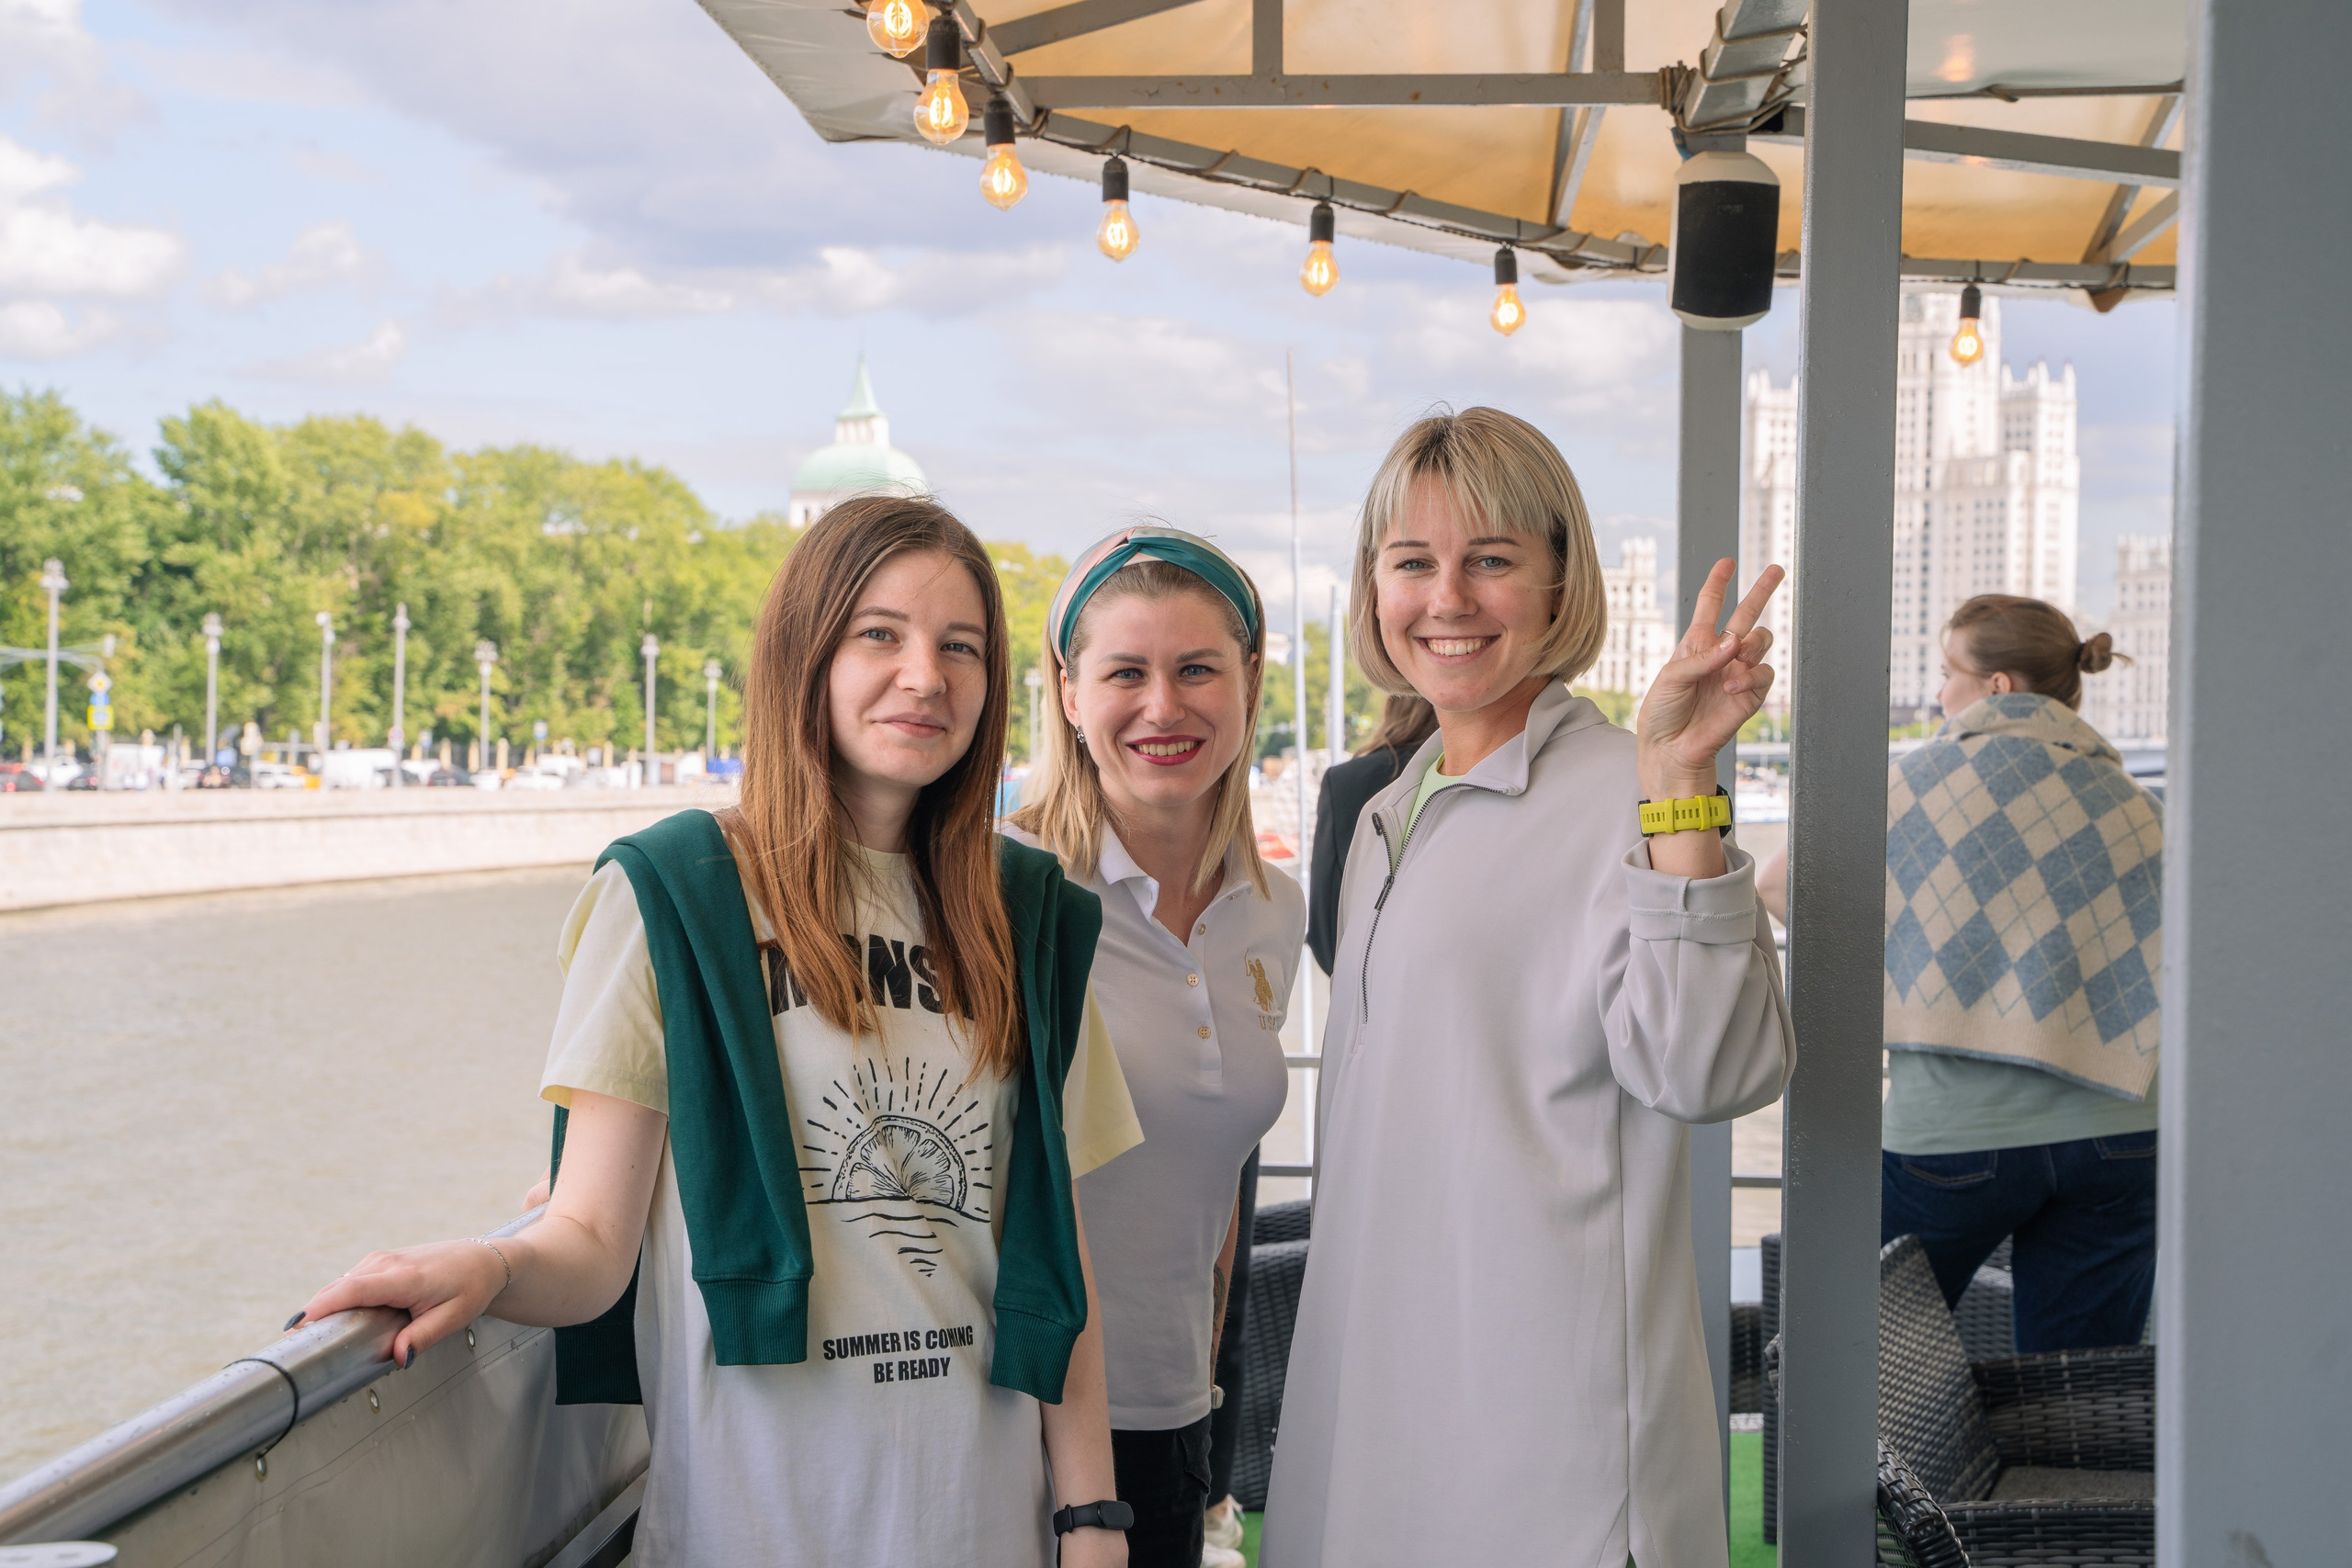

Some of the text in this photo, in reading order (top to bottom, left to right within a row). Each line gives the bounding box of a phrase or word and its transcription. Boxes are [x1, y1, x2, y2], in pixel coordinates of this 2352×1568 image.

[823, 1332, 902, 1360] SUMMER
[904, 1330, 921, 1351] IS
[874, 1357, 951, 1383] BE READY
